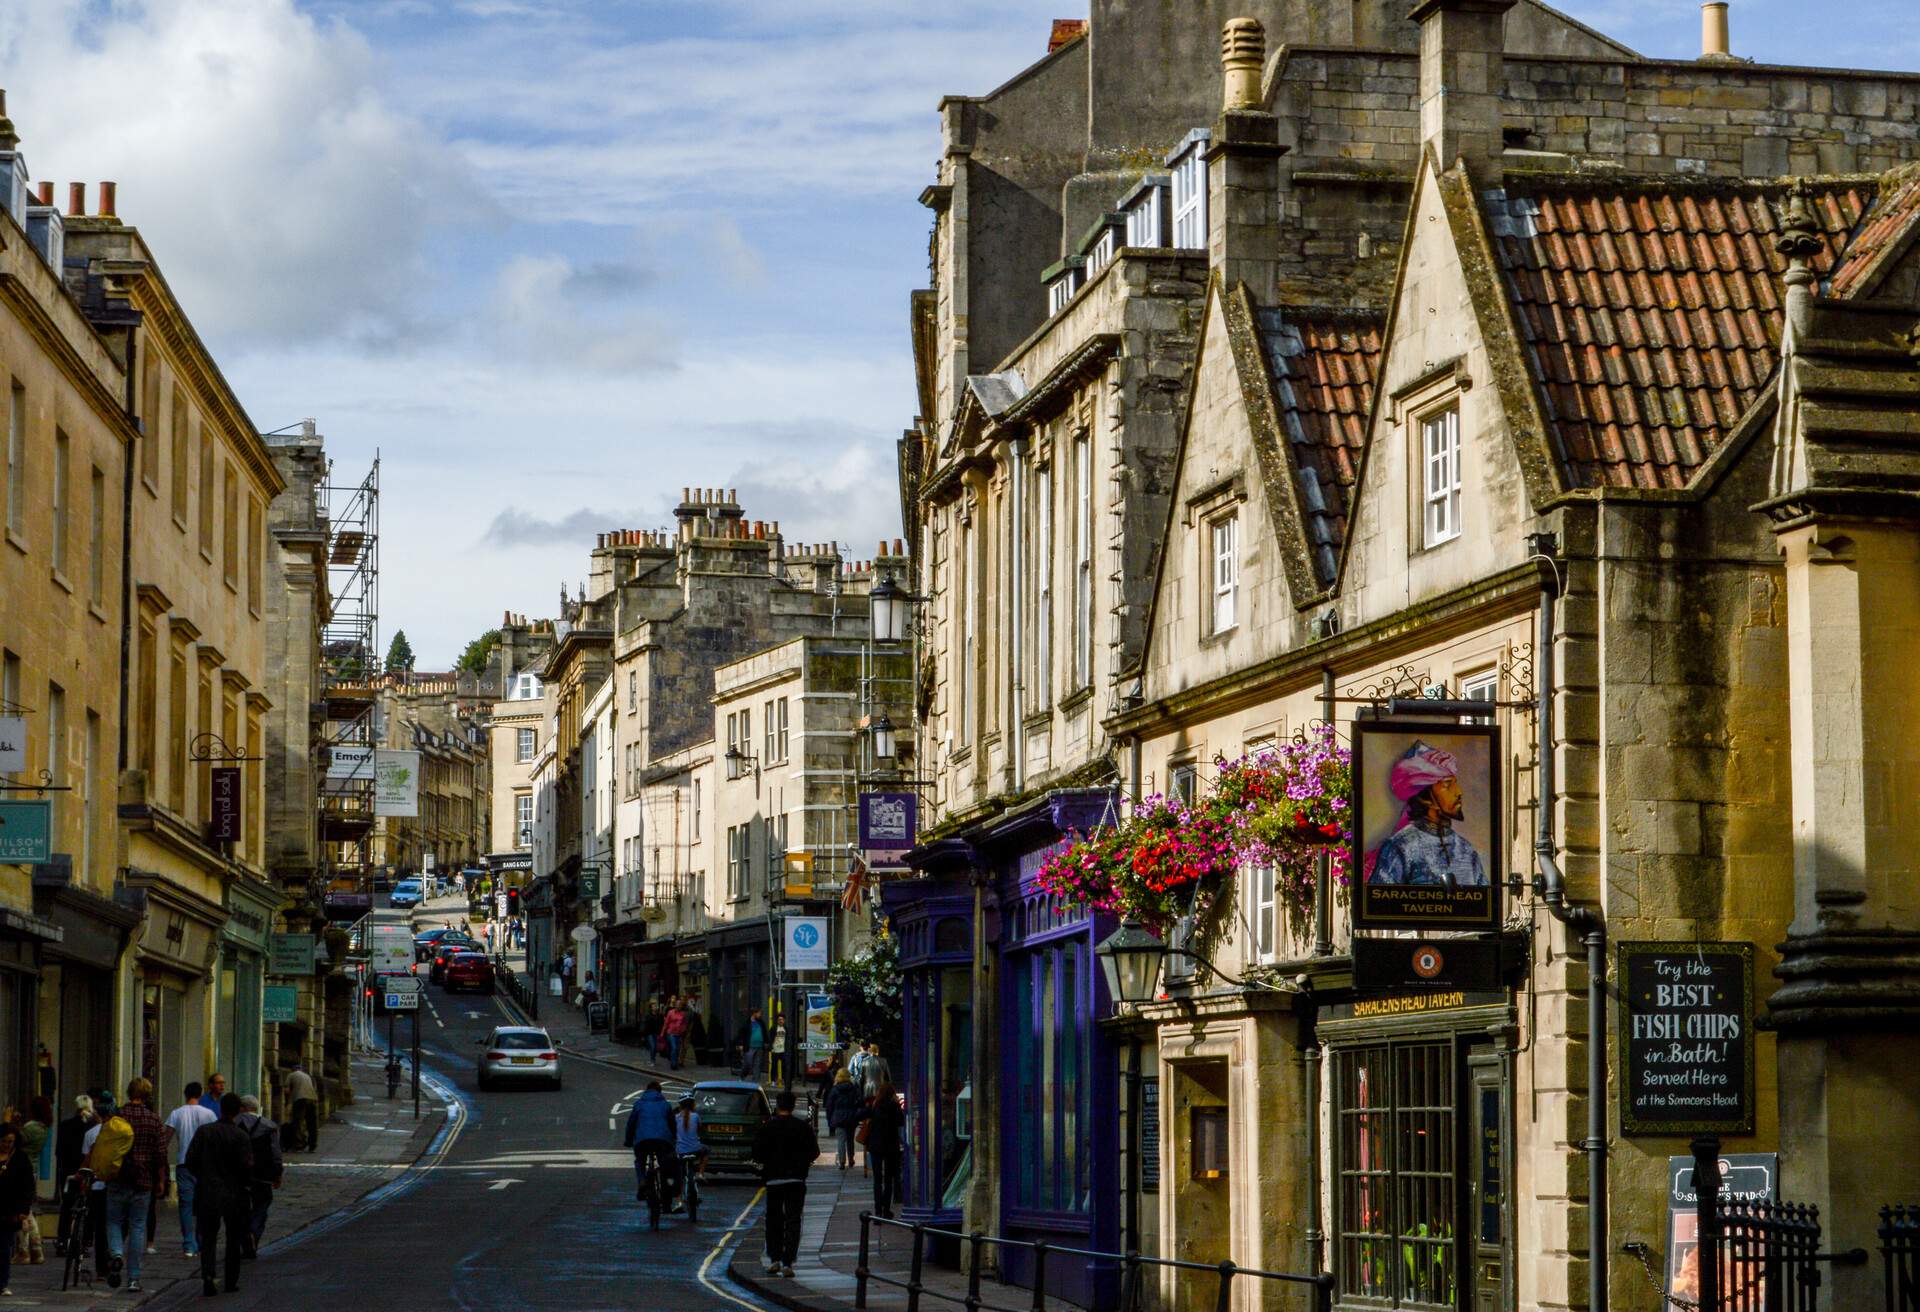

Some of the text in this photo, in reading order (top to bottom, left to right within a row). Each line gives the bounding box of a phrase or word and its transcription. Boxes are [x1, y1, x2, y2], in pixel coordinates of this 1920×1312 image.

[335, 752, 373, 763] Emery
[215, 772, 237, 796] sally
[216, 813, 237, 838] long
[1, 847, 34, 857] LACE
[1372, 889, 1483, 901] SARACENS HEAD
[1402, 904, 1453, 913] TAVERN
[1654, 960, 1712, 981] Try the
[1354, 992, 1464, 1016] SARACENS HEAD TAVERN
[1656, 984, 1714, 1007] BEST
[1633, 1014, 1740, 1040] FISH CHIPS
[1644, 1042, 1727, 1063] in Bath!
[1642, 1069, 1727, 1086] Served Here
[1636, 1093, 1738, 1106] at the Saracens Head
